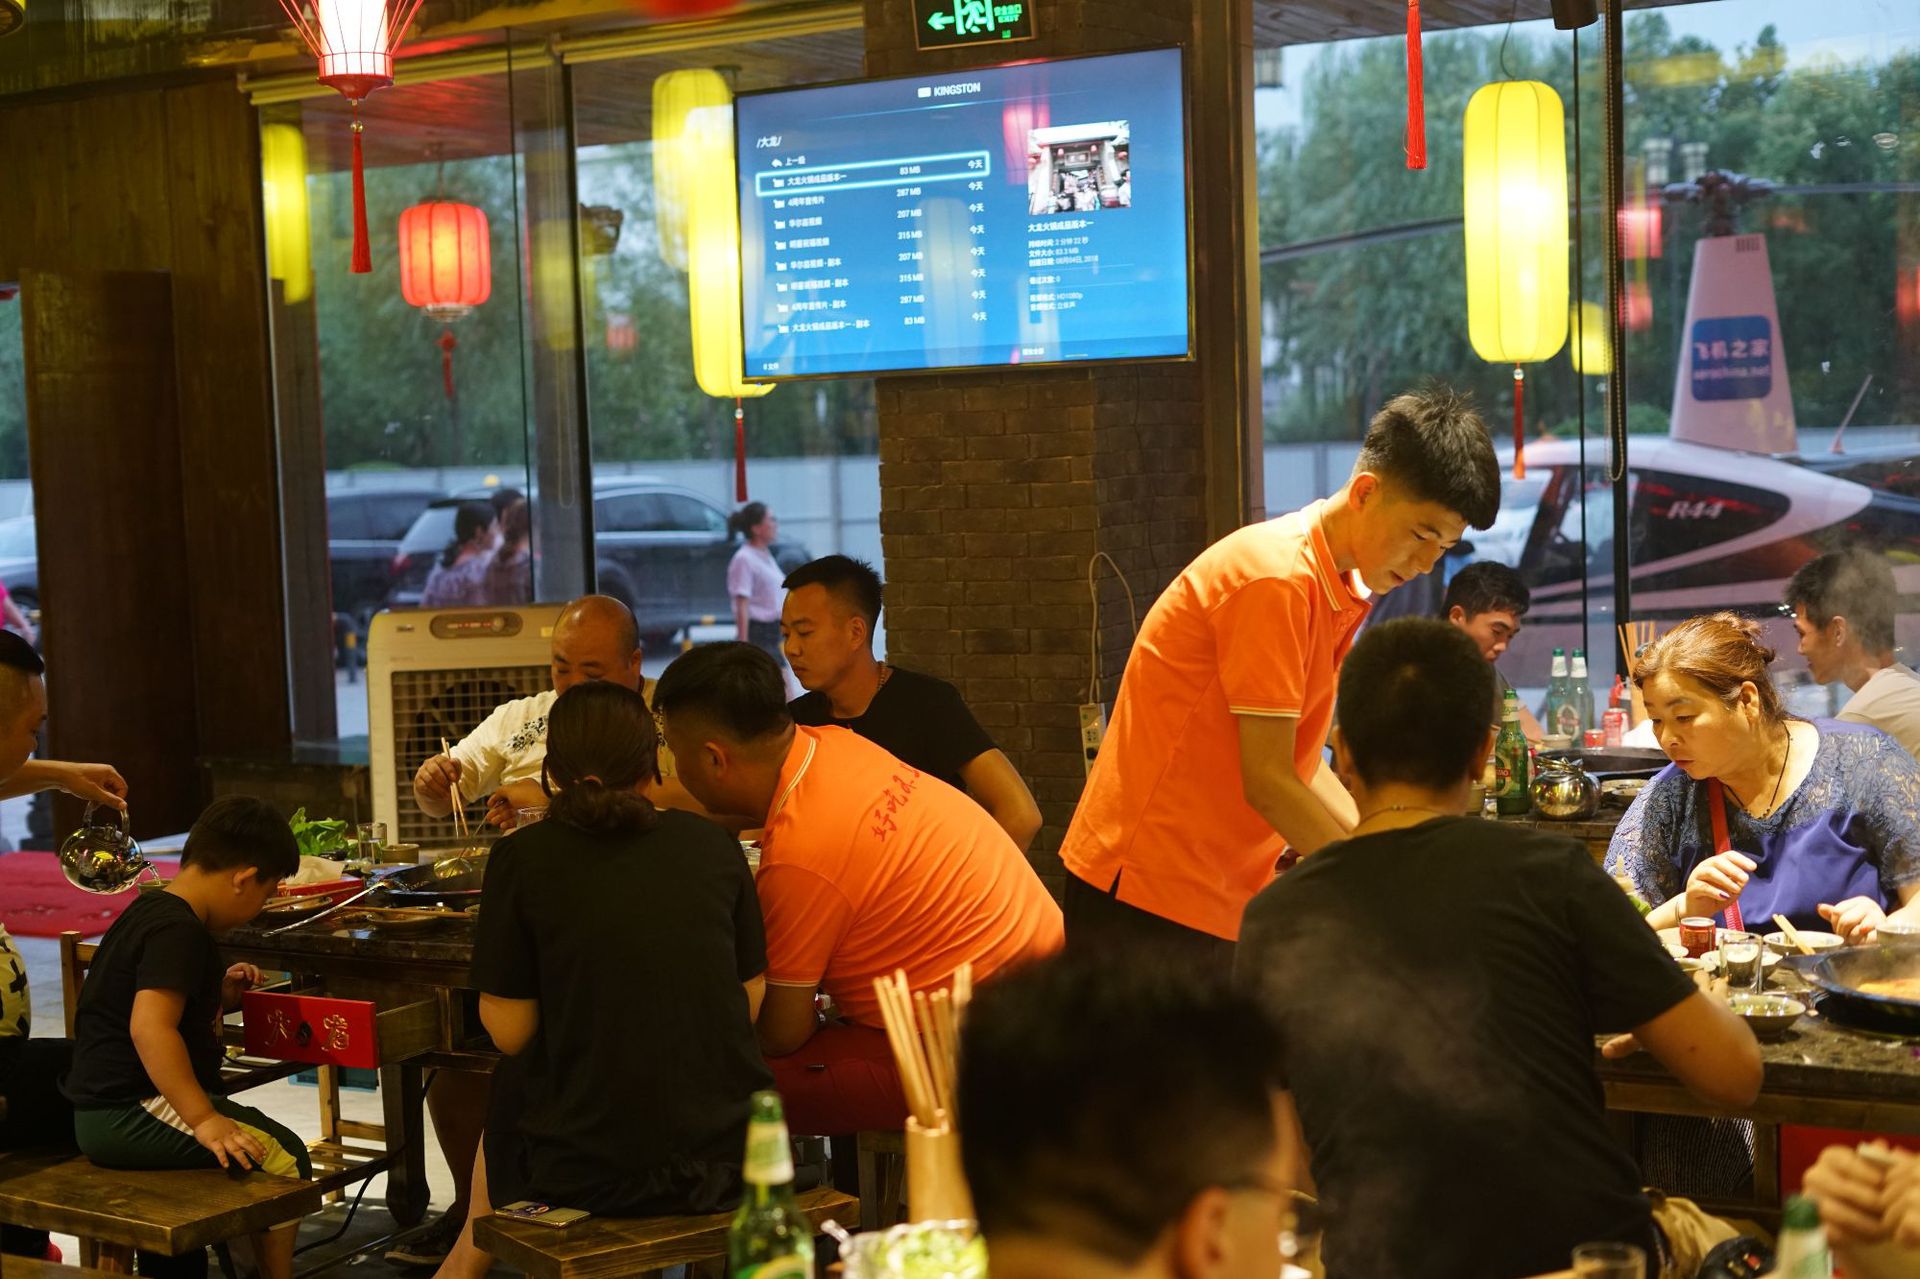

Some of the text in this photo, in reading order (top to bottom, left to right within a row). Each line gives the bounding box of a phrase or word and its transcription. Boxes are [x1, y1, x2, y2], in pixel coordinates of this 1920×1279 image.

[934, 82, 981, 97] KINGSTON
[968, 159, 983, 169] 今天
[968, 181, 983, 191] 今天
[969, 203, 984, 213] 今天
[970, 225, 985, 235] 今天
[970, 246, 985, 257] 今天
[971, 268, 986, 279] 今天
[971, 290, 987, 300] 今天
[972, 311, 987, 322] 今天
[1693, 338, 1768, 360] 飞机之家
[1666, 500, 1726, 520] R44
